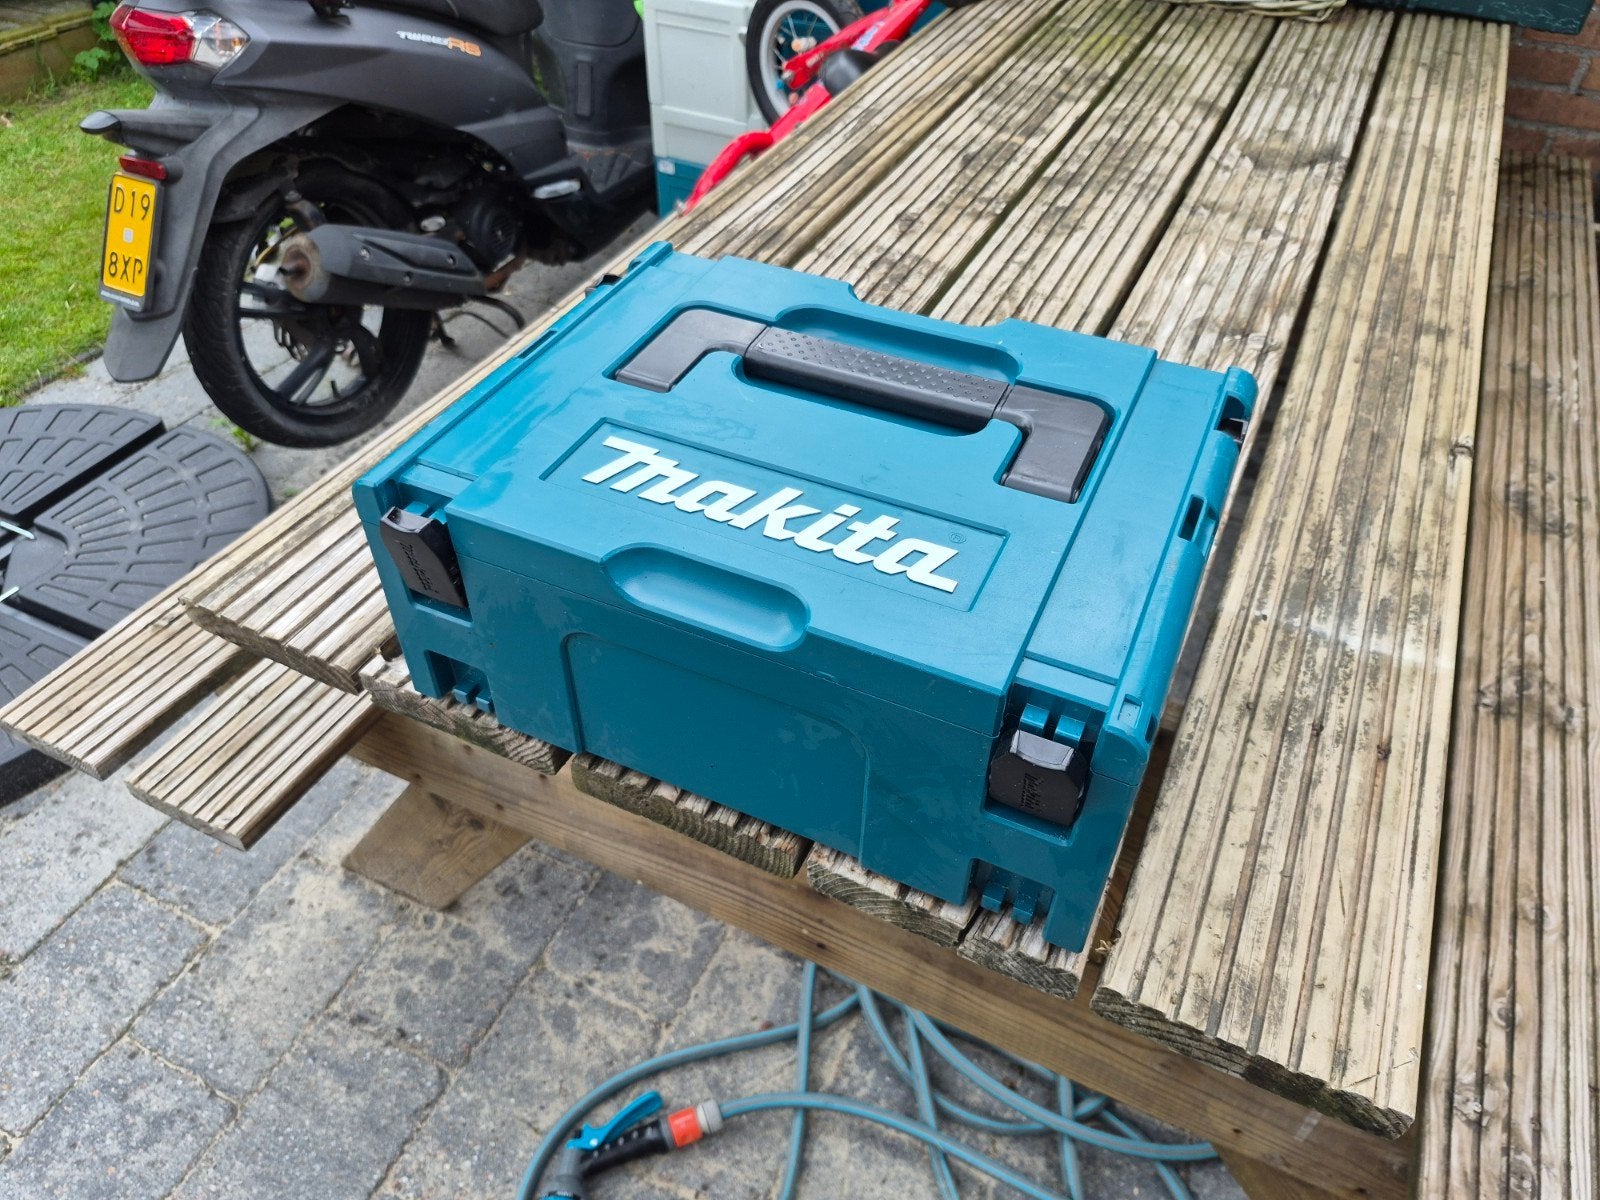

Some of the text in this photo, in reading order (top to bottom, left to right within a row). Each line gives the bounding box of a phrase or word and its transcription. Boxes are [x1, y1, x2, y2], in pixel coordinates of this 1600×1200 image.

[113, 186, 151, 220] D19
[108, 251, 143, 284] 8XP
[581, 435, 959, 594] makita
